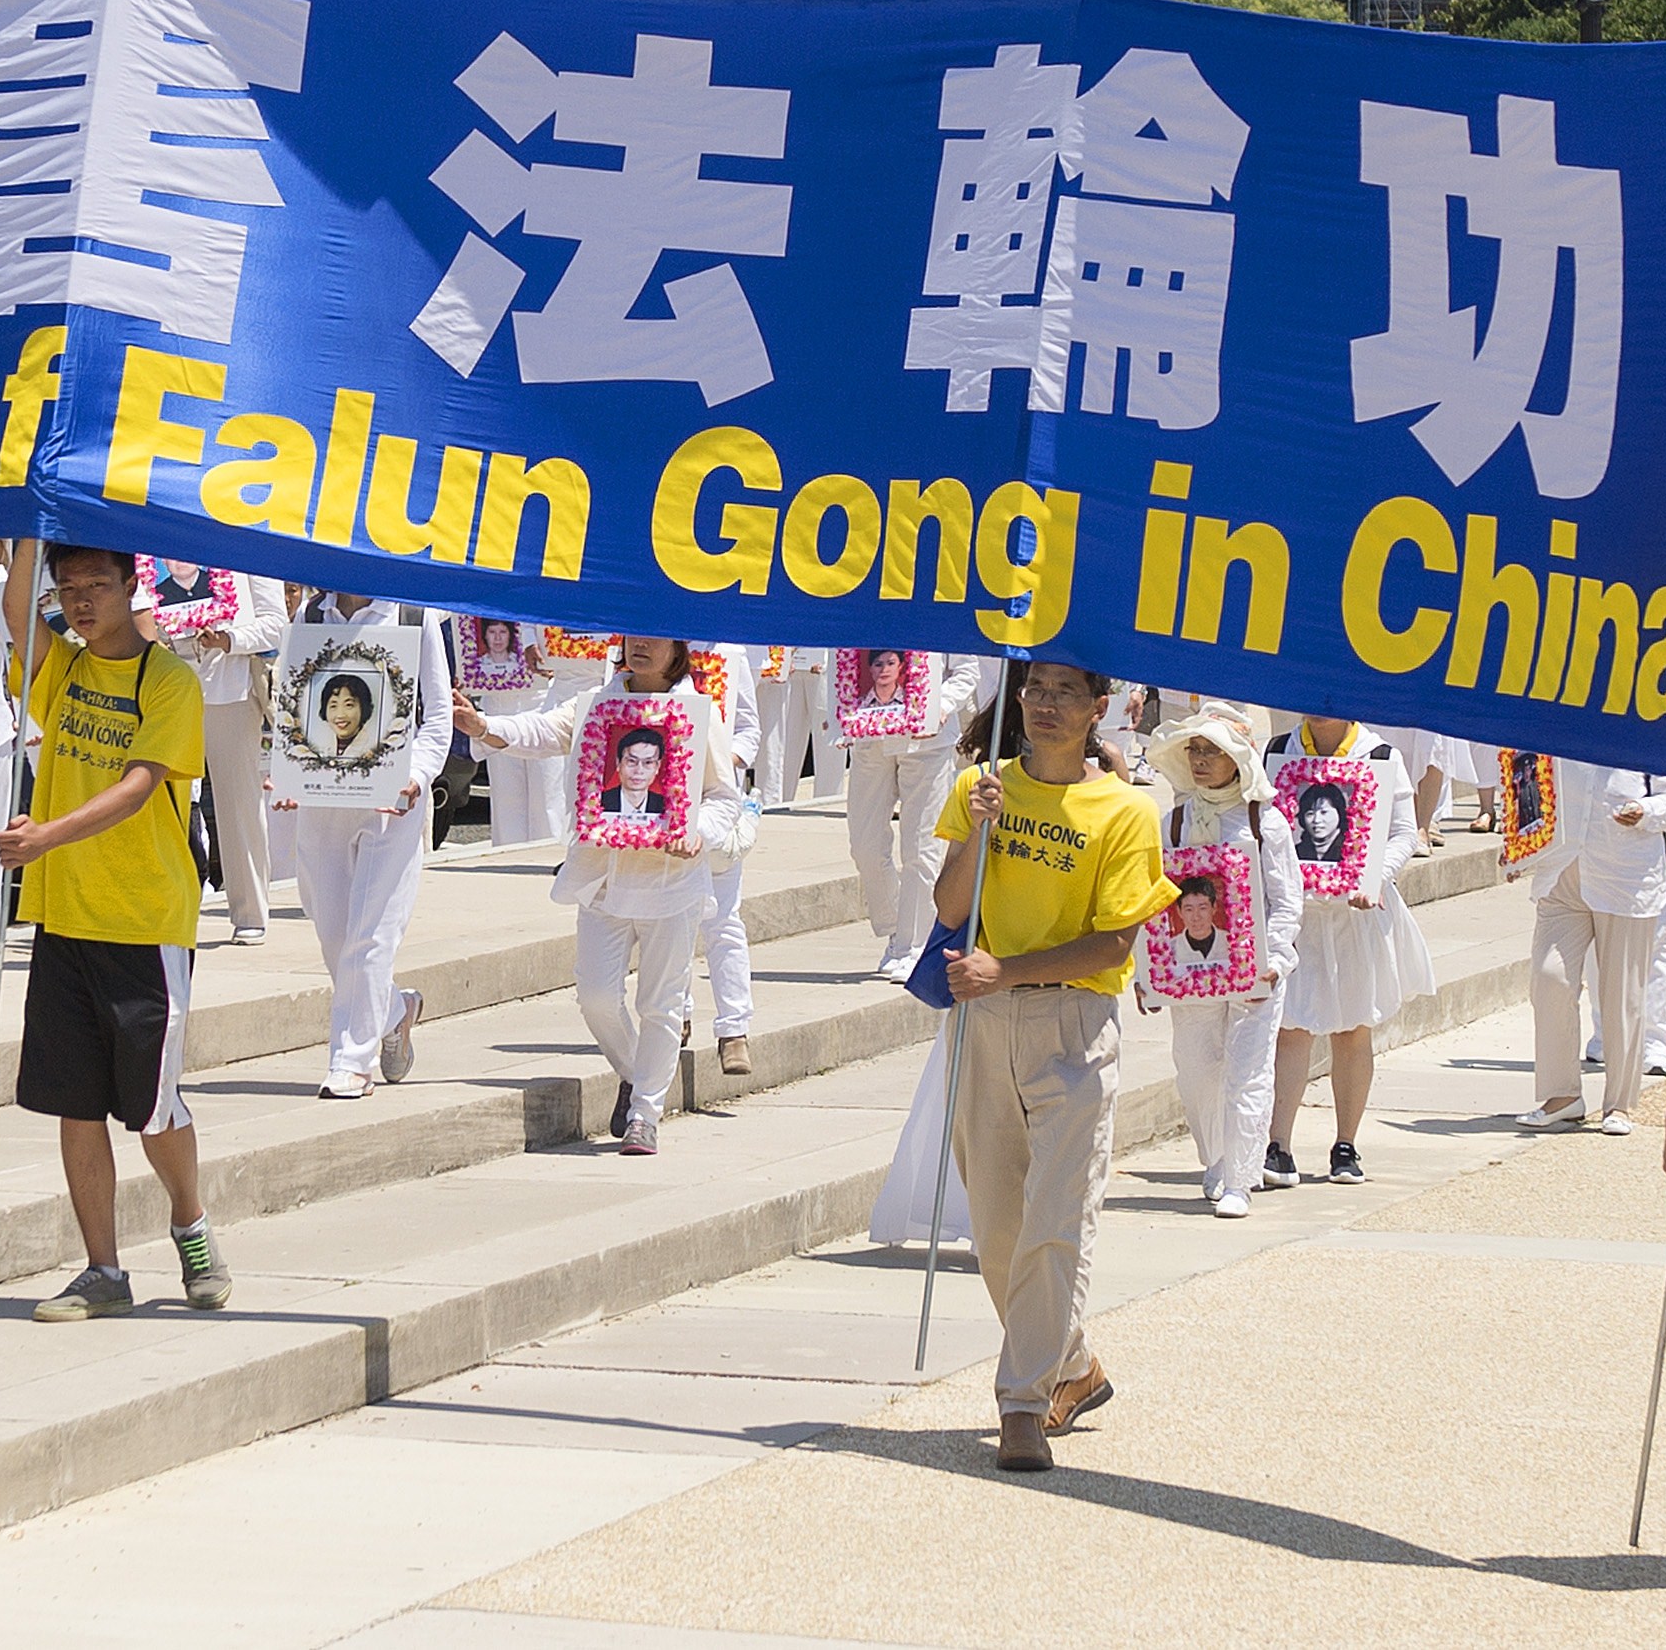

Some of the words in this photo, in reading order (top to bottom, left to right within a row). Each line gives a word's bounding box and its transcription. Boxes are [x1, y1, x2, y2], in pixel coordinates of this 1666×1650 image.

[103, 346, 591, 581] Falun
[651, 426, 1080, 647] Gong
[1135, 461, 1289, 653] in
[78, 689, 118, 710] CHNA:
[997, 811, 1037, 837] ALUN
[1038, 822, 1088, 850] GONG
